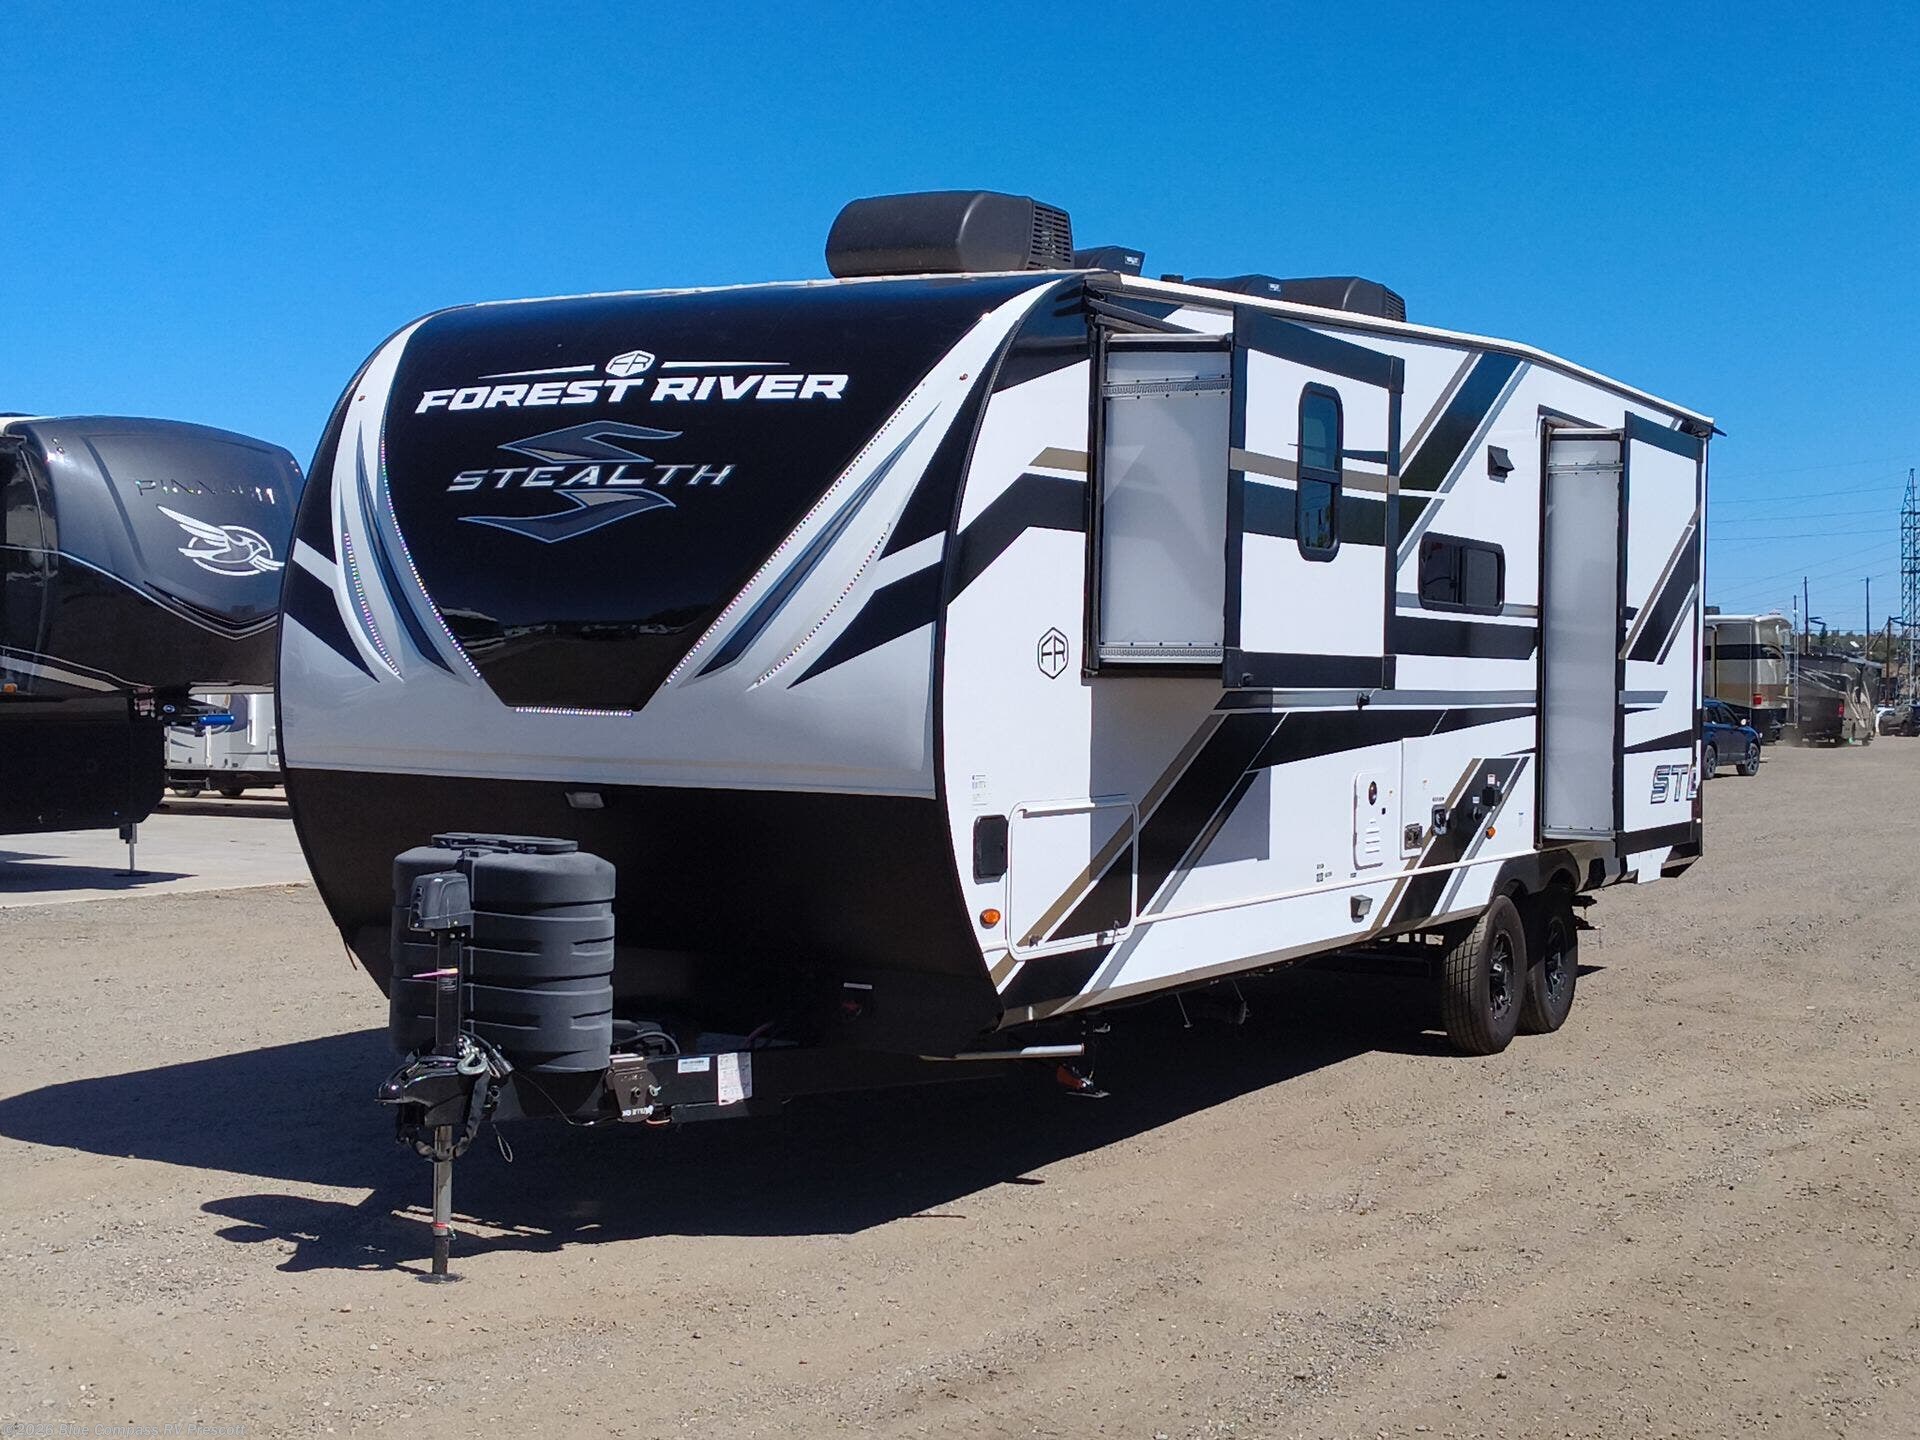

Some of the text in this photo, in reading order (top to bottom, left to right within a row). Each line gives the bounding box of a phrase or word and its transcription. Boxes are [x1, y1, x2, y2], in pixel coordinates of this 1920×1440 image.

[415, 374, 849, 414] FOREST RIVER
[446, 463, 736, 491] STEALTH
